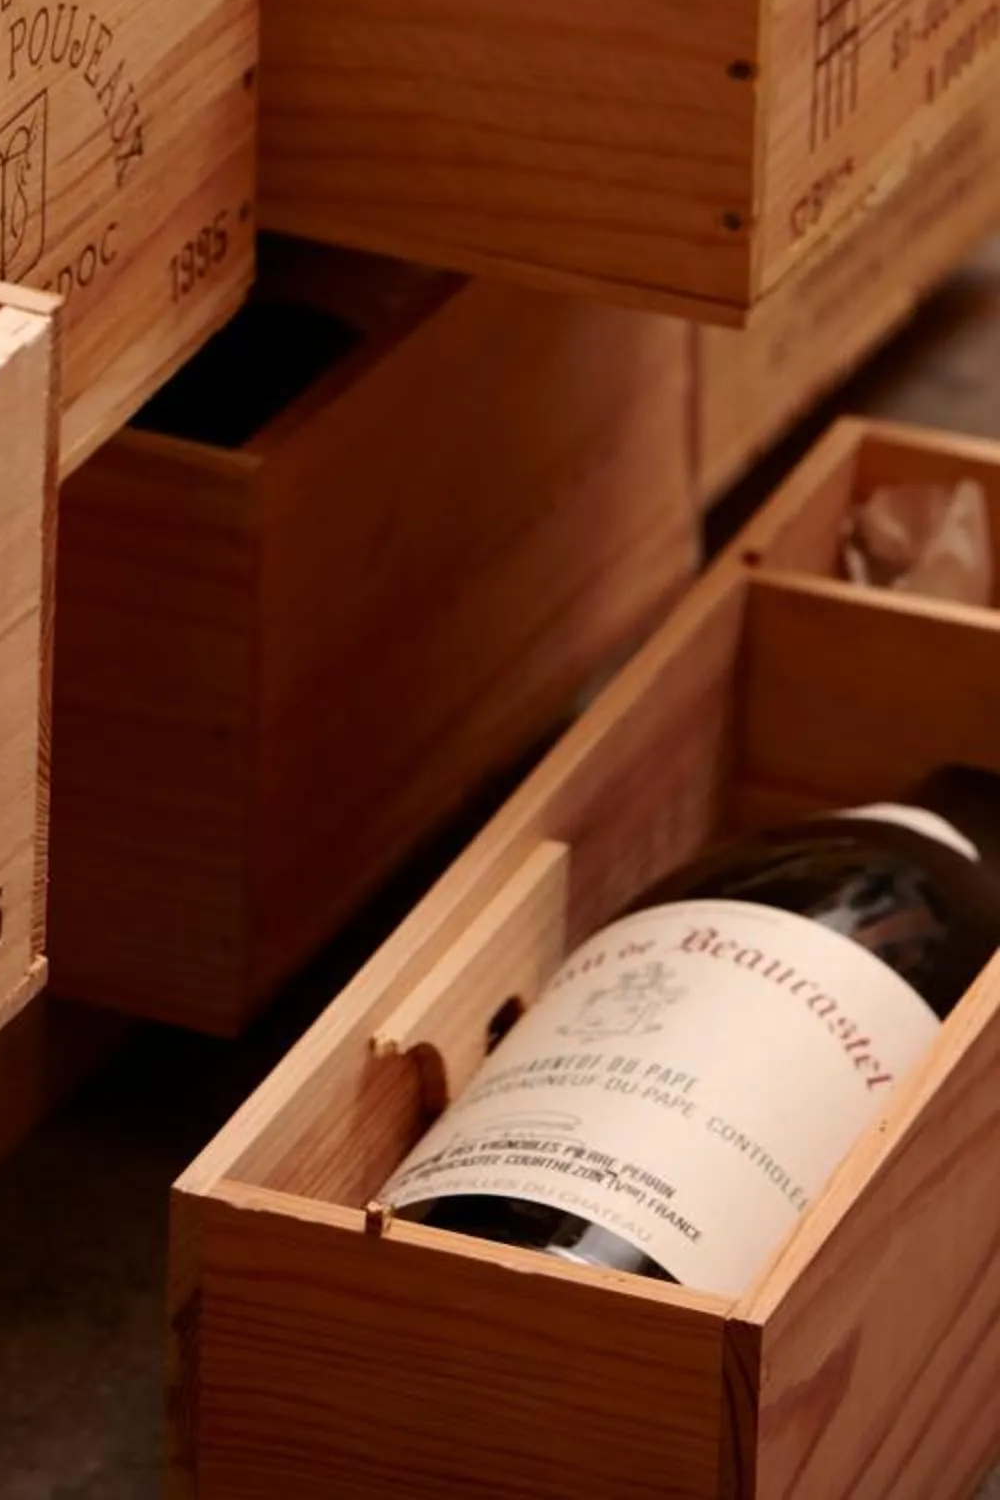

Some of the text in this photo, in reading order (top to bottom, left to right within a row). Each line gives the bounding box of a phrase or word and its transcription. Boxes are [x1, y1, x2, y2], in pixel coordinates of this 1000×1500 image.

[8, 3, 145, 190] POUJEAUX
[42, 221, 120, 301] DOC
[679, 926, 893, 1092] Beaucastel
